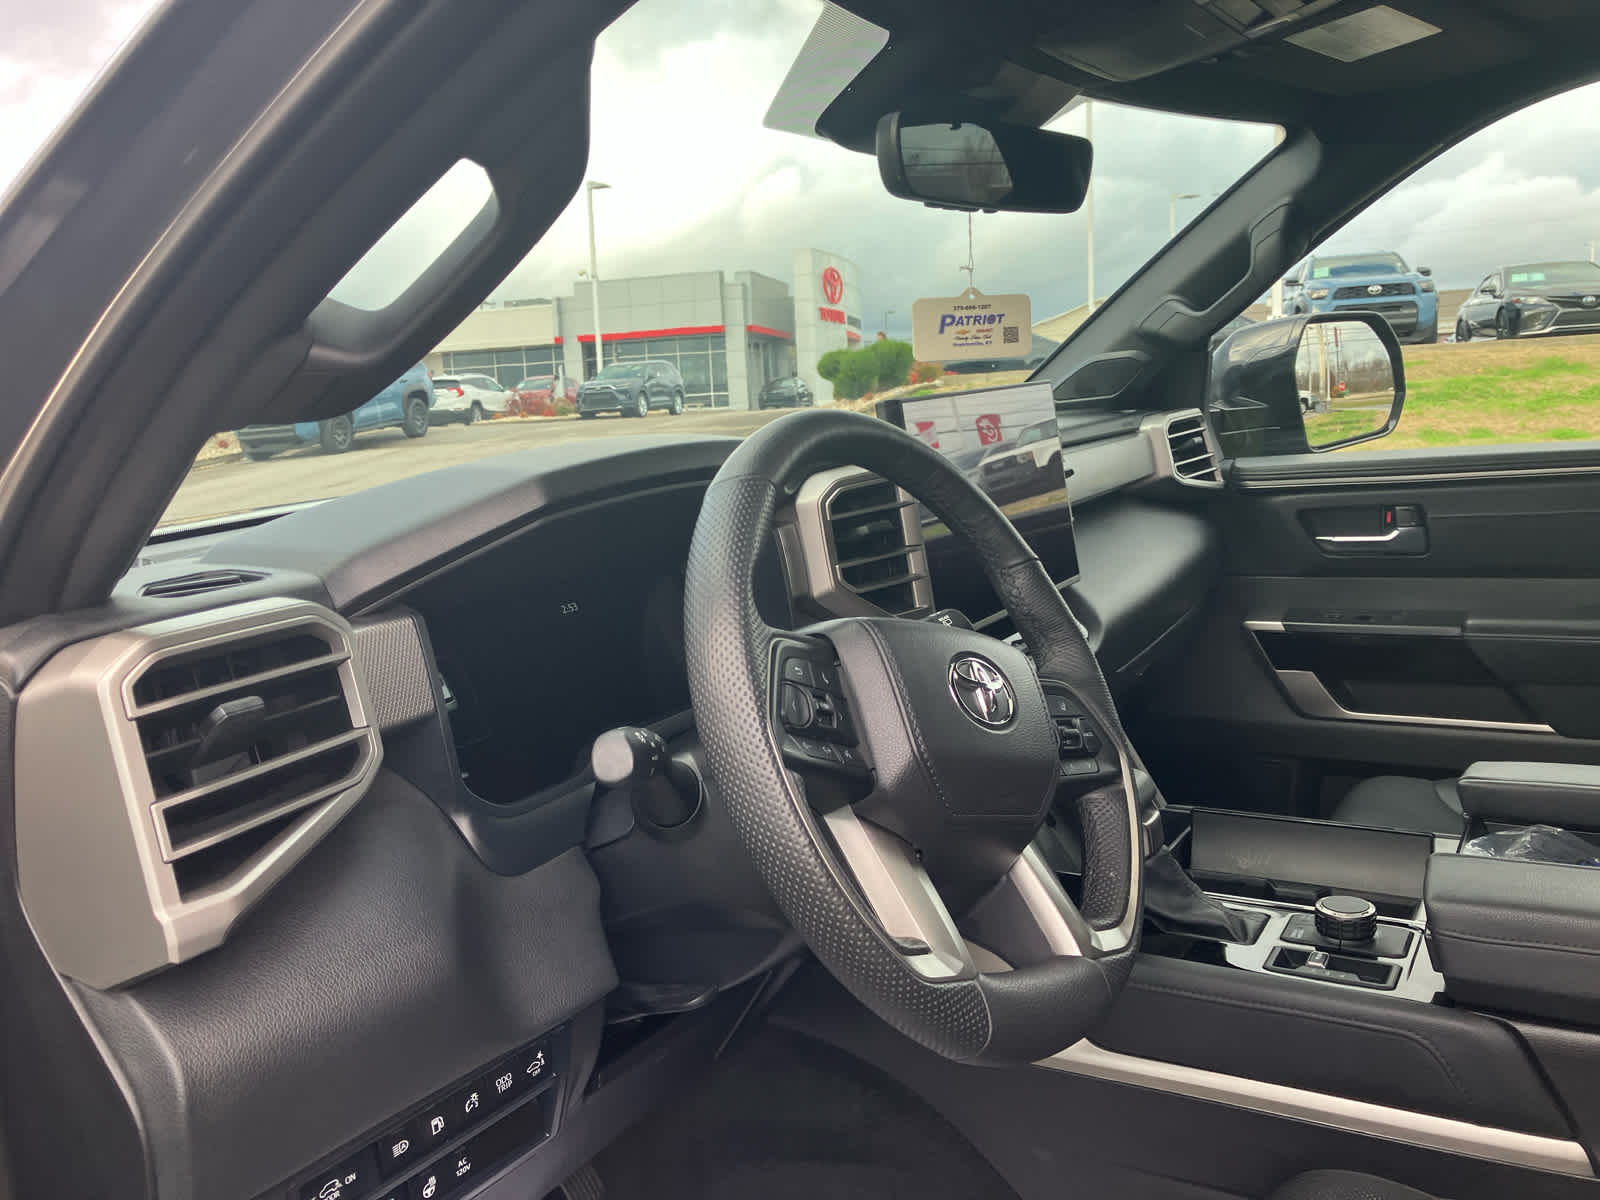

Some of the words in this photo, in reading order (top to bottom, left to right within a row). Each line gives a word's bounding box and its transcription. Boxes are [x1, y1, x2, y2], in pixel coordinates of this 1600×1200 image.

[938, 313, 1006, 334] PATRIOT
[495, 1072, 512, 1087] ODO
[497, 1080, 513, 1094] TRIP
[458, 1157, 468, 1168] AC
[456, 1163, 471, 1177] 120V
[344, 1172, 357, 1185] ON
